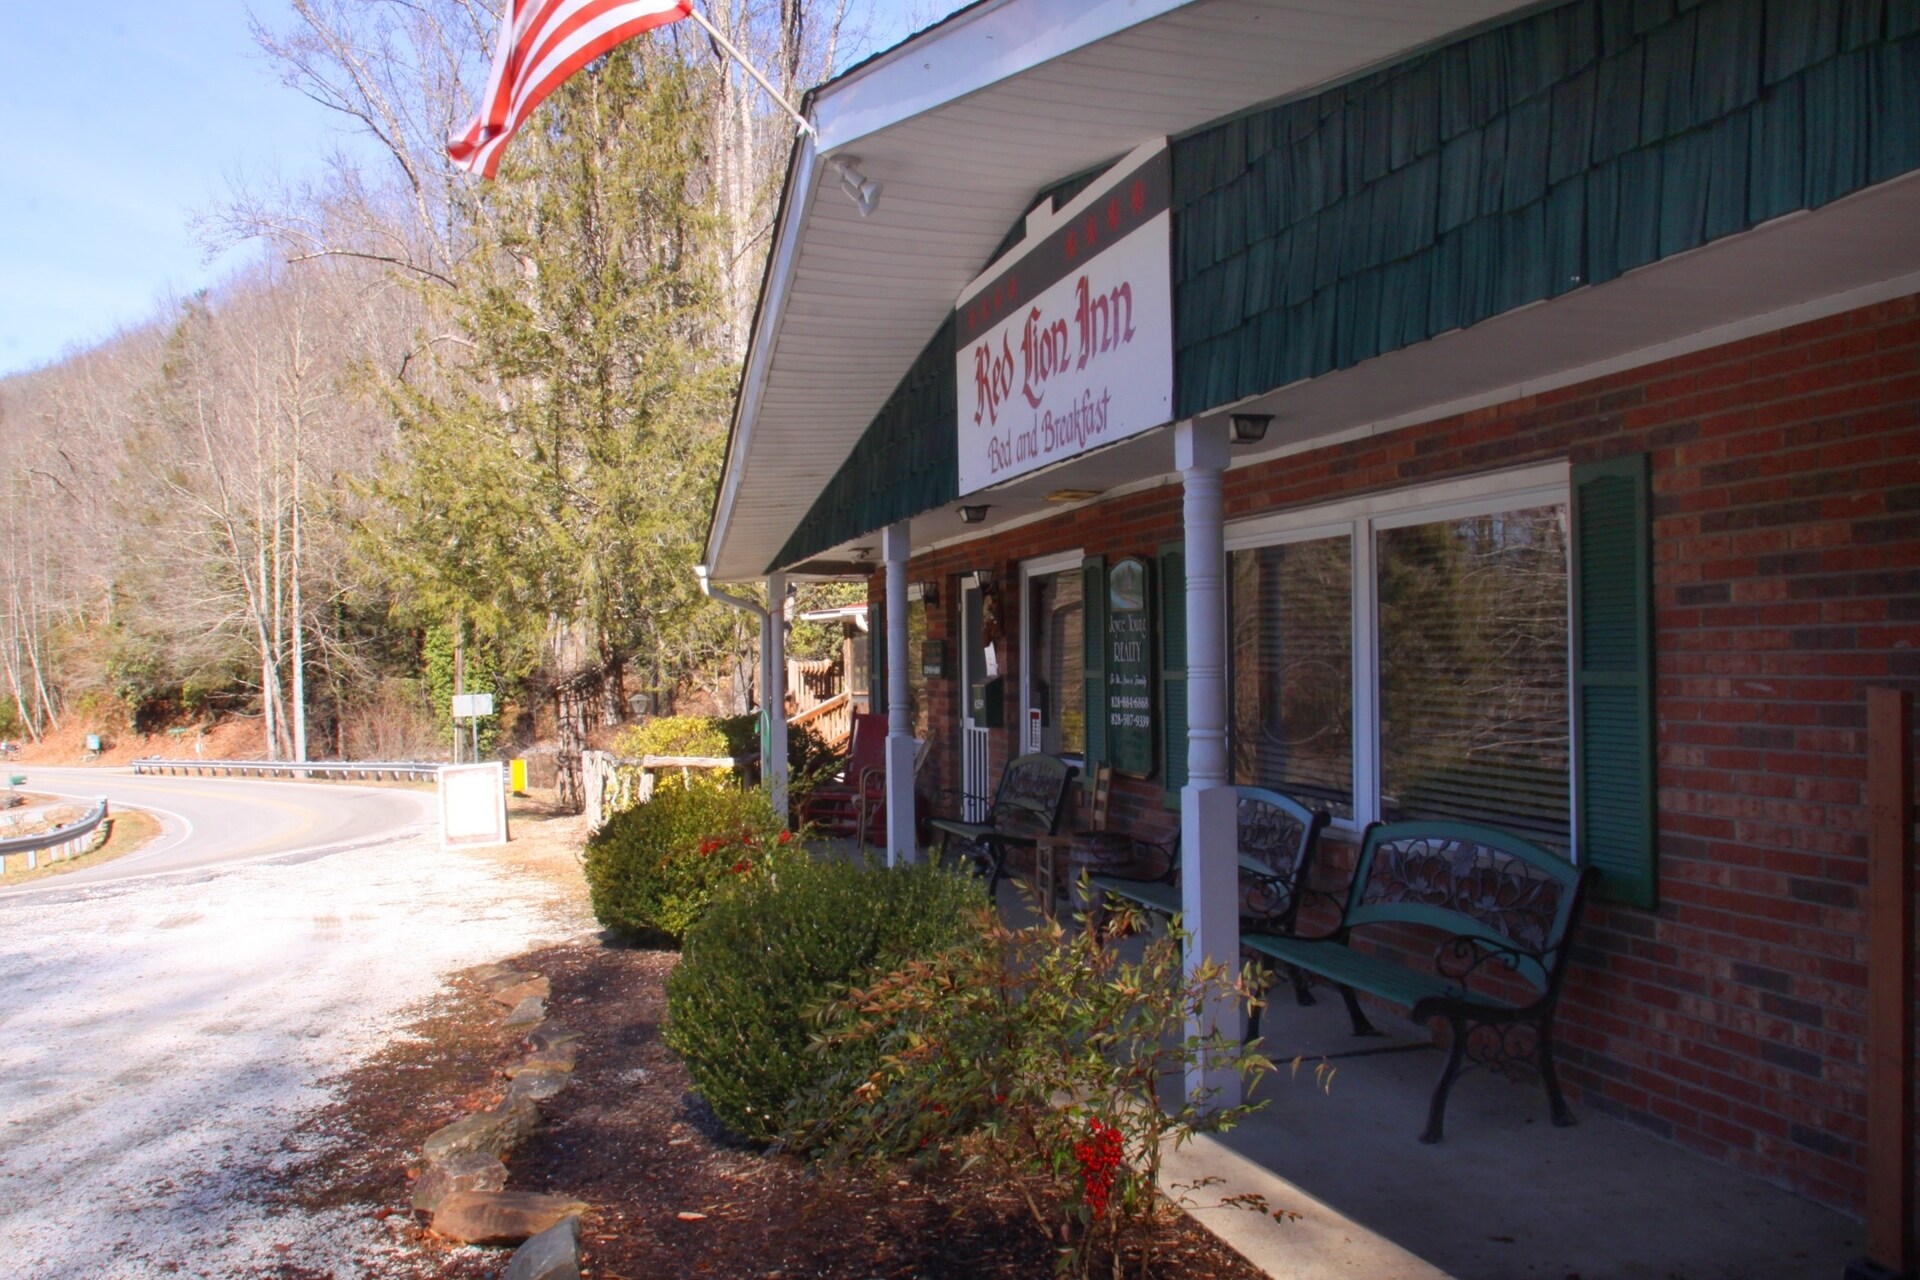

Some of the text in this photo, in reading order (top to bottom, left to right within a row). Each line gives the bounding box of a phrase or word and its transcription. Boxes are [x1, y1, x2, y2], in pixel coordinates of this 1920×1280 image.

[974, 275, 1137, 427] Red Lion Inn
[987, 386, 1112, 475] Bed and Breakfast
[1109, 613, 1147, 639] Joyce Young
[1113, 641, 1142, 662] REALTY
